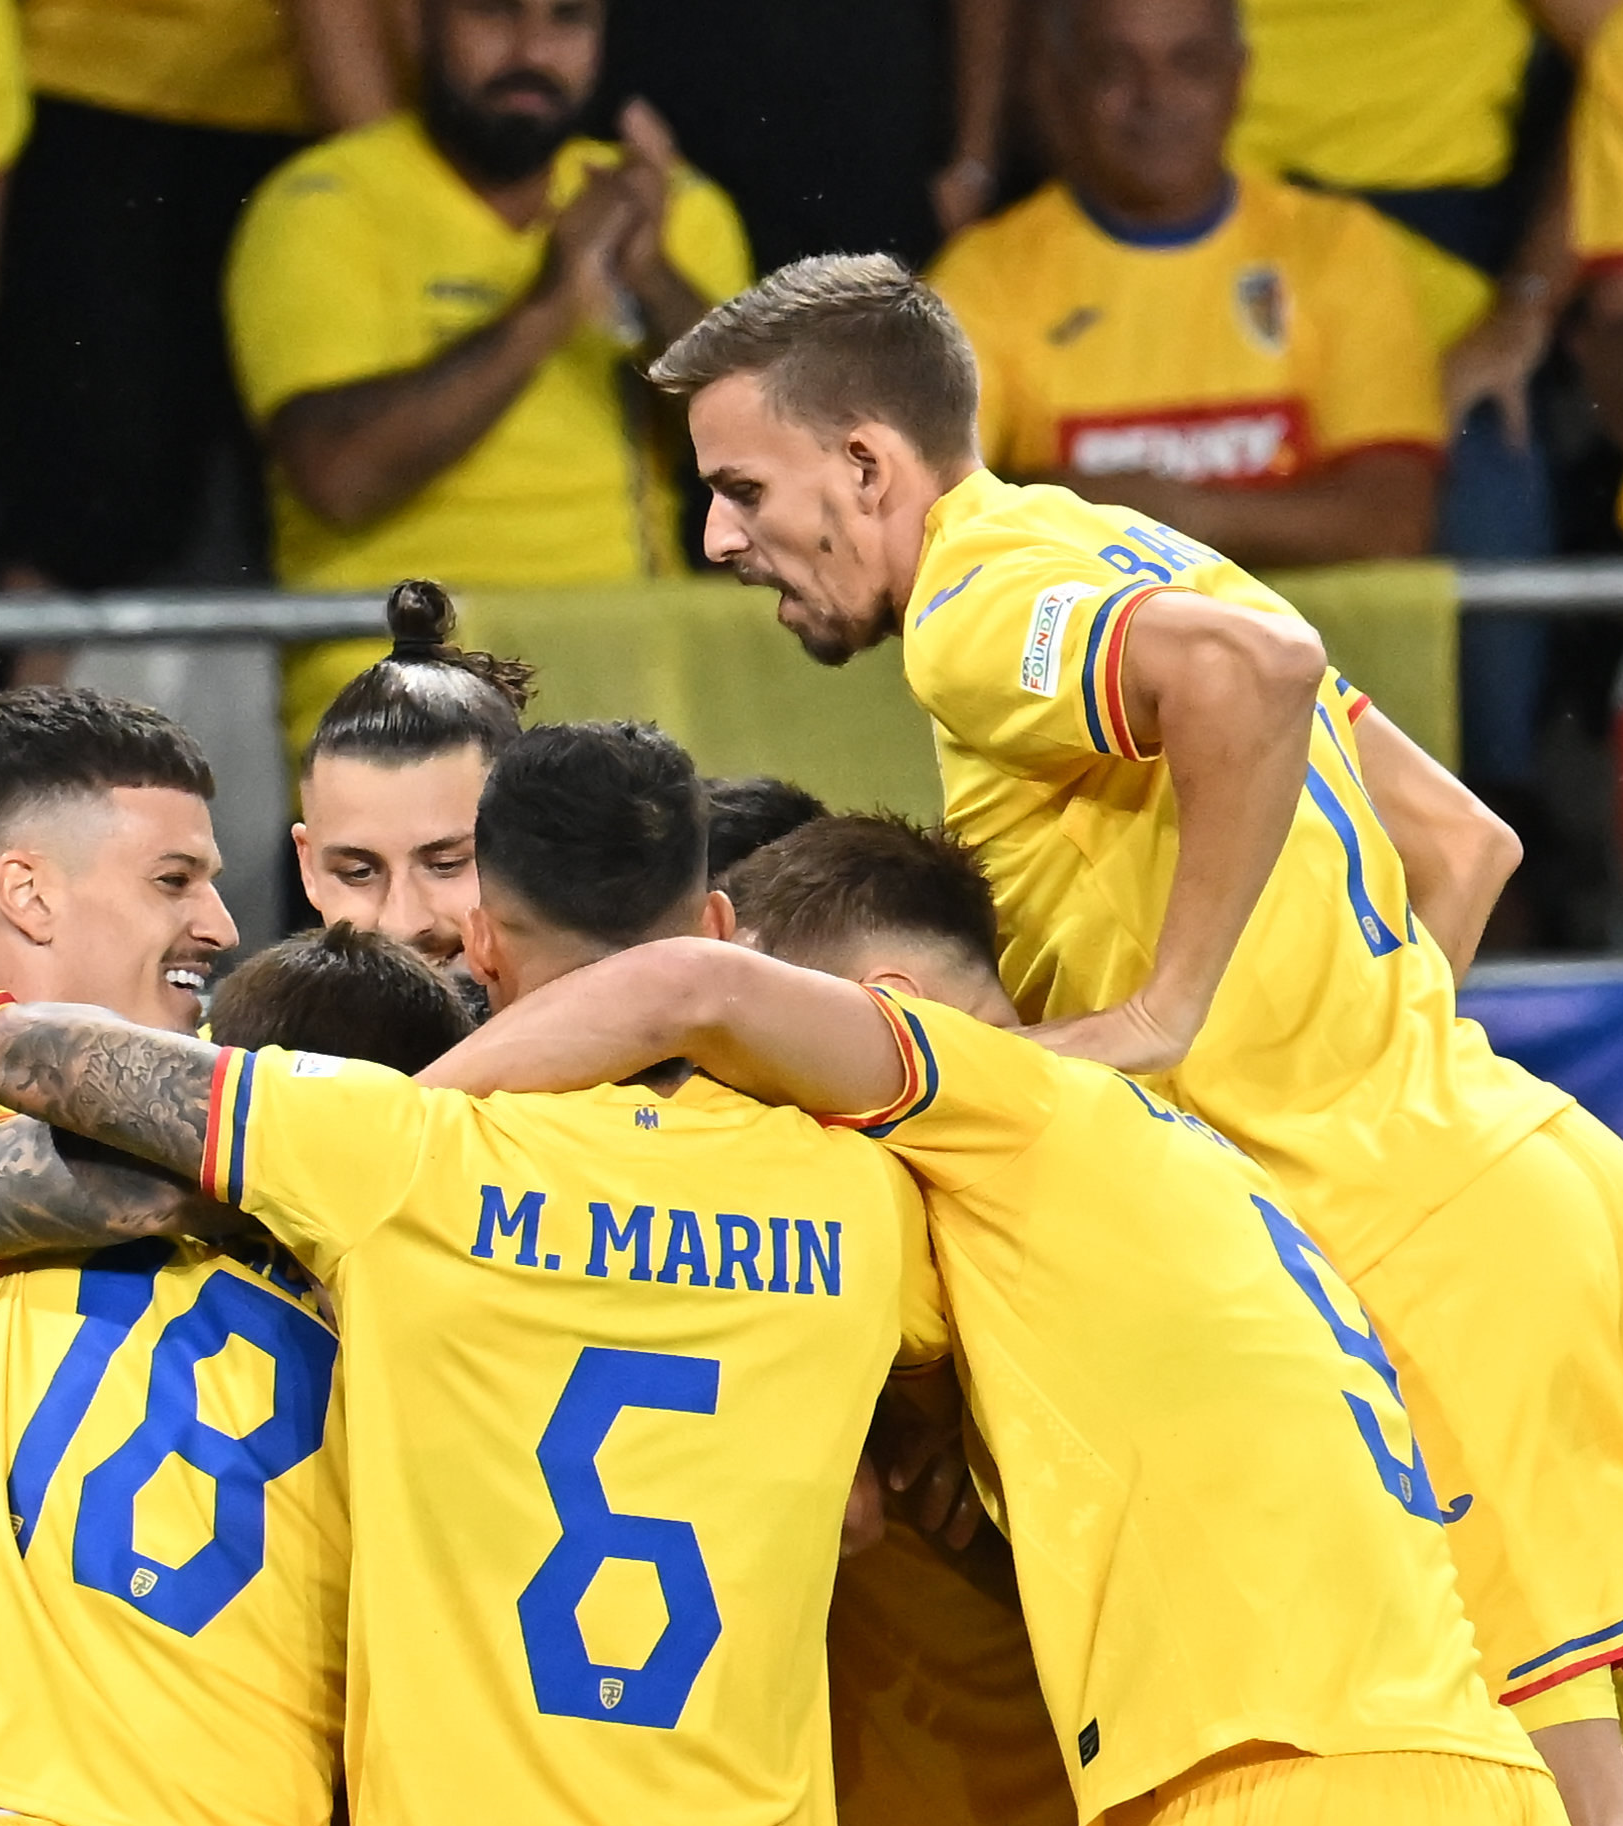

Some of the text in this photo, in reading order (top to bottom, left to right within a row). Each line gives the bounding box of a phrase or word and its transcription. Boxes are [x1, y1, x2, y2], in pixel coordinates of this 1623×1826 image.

[1029, 594, 1060, 691] FOUNDAT
[471, 1184, 843, 1298] M. MARIN
[7, 1236, 340, 1637] 18
[517, 1347, 723, 1730] 6
